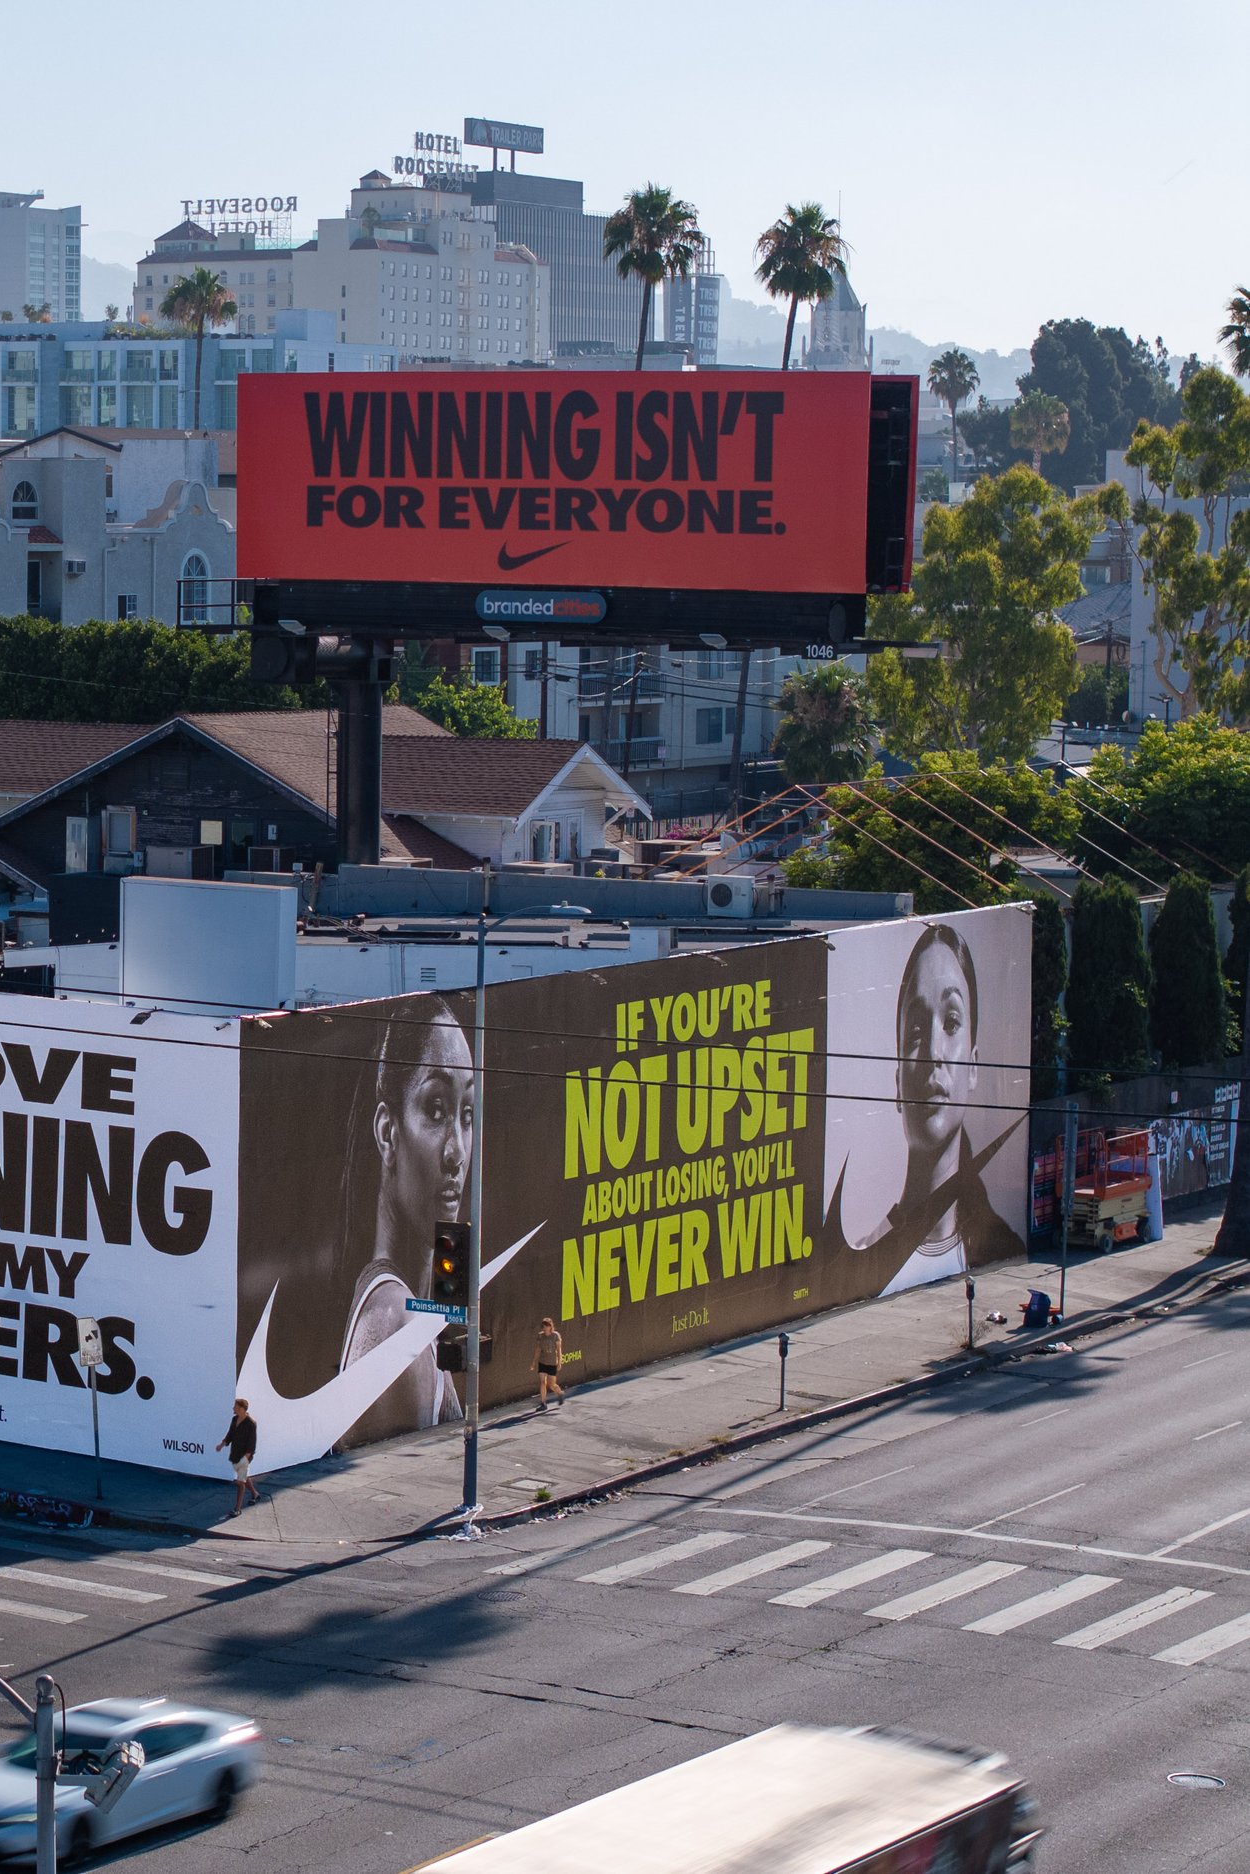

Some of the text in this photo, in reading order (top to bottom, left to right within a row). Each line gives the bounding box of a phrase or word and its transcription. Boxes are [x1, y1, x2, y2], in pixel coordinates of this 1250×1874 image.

[415, 131, 461, 155] HOTEL
[490, 126, 543, 148] TRAILER PARK
[394, 155, 479, 183] ROOSEVELT
[304, 389, 785, 482] WINNING ISN'T
[306, 484, 787, 535] FOR EVERYONE.
[805, 644, 834, 659] 1046
[616, 979, 771, 1053] IF YOU'RE
[564, 1027, 815, 1180] NOT UPSET
[581, 1139, 795, 1226] ABOUT LOSING, YOU'LL
[561, 1183, 813, 1322] NEVER WIN.
[411, 1300, 460, 1314] Poinsettia Pl
[793, 1287, 809, 1300] SMITH
[671, 1314, 688, 1337] Just
[689, 1310, 701, 1328] Do
[561, 1350, 582, 1364] SOPHIA
[162, 1438, 204, 1455] WILSON
